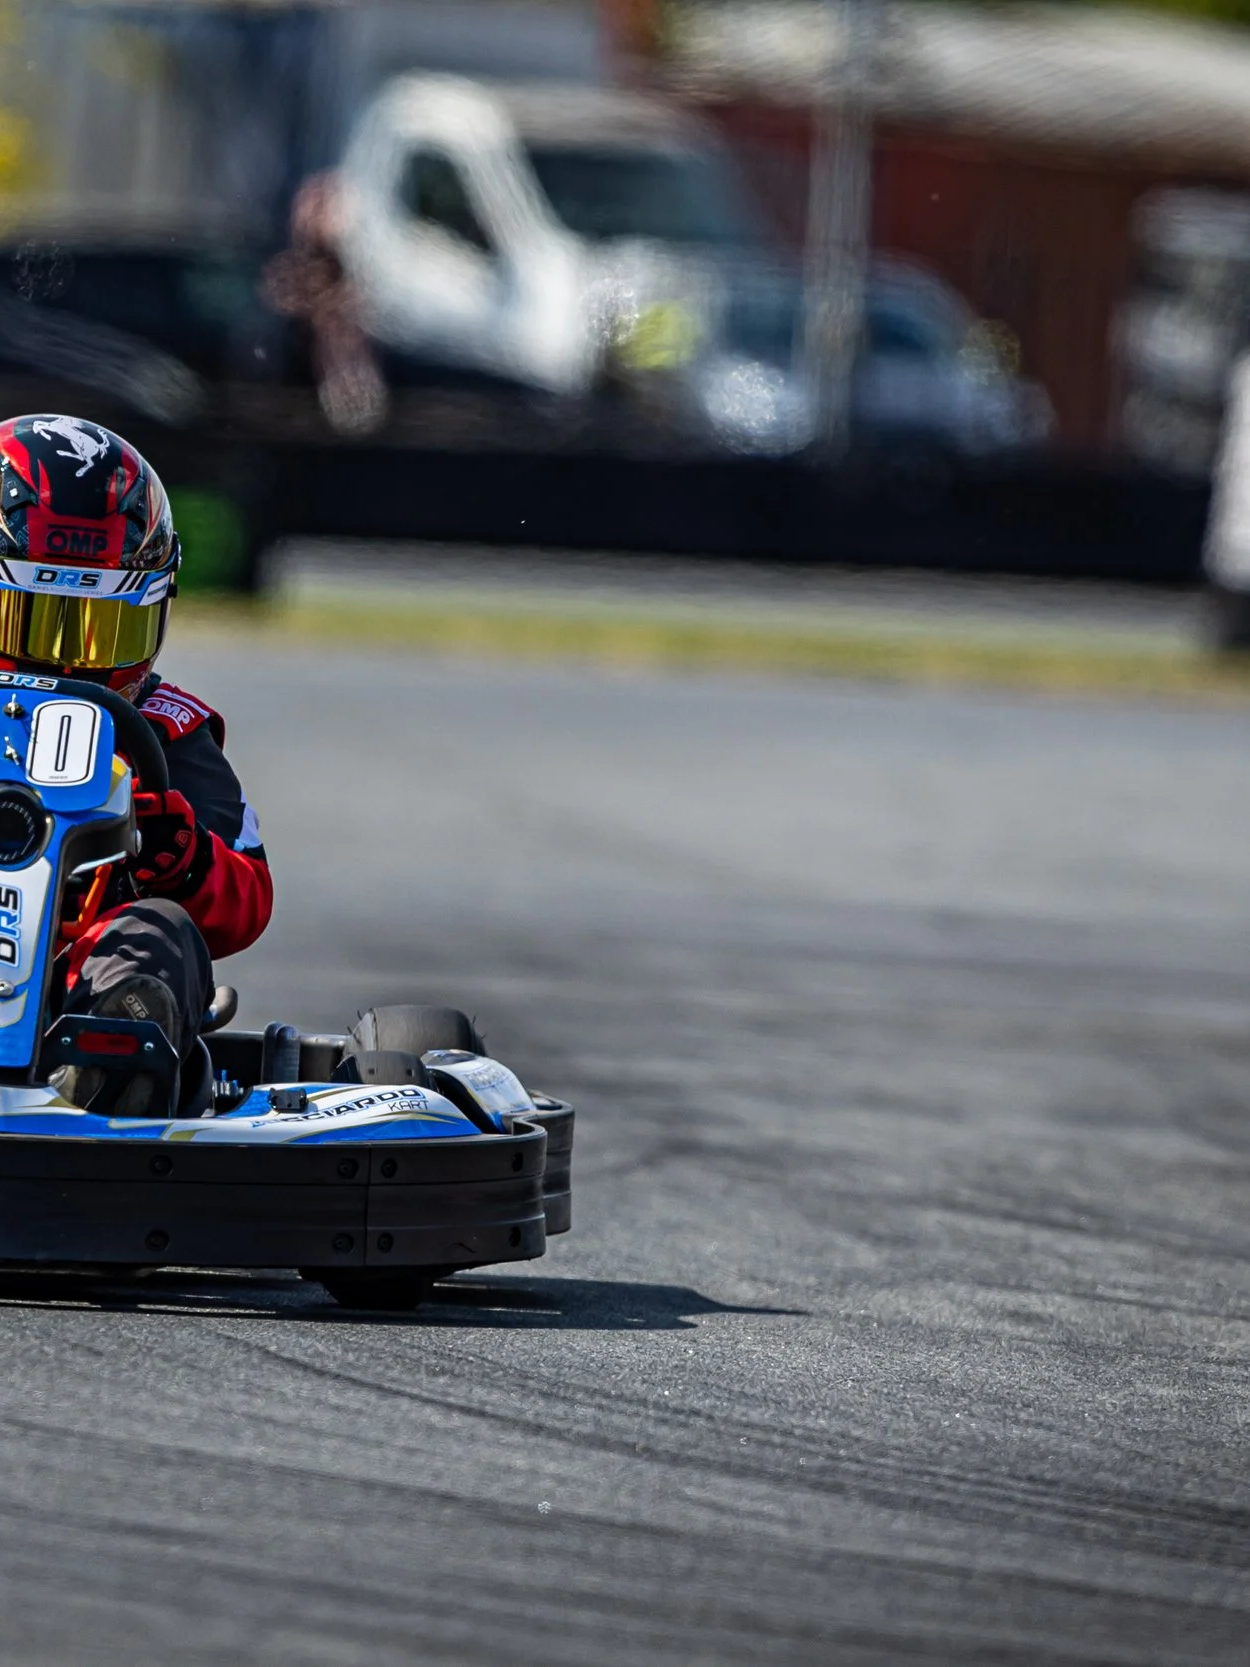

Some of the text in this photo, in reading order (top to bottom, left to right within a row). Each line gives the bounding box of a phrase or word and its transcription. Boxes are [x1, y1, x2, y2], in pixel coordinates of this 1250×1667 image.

[46, 531, 108, 556] OMP
[34, 567, 102, 588] DRS
[142, 700, 191, 725] OMP
[125, 994, 147, 1018] OMP
[387, 1099, 430, 1112] KART
